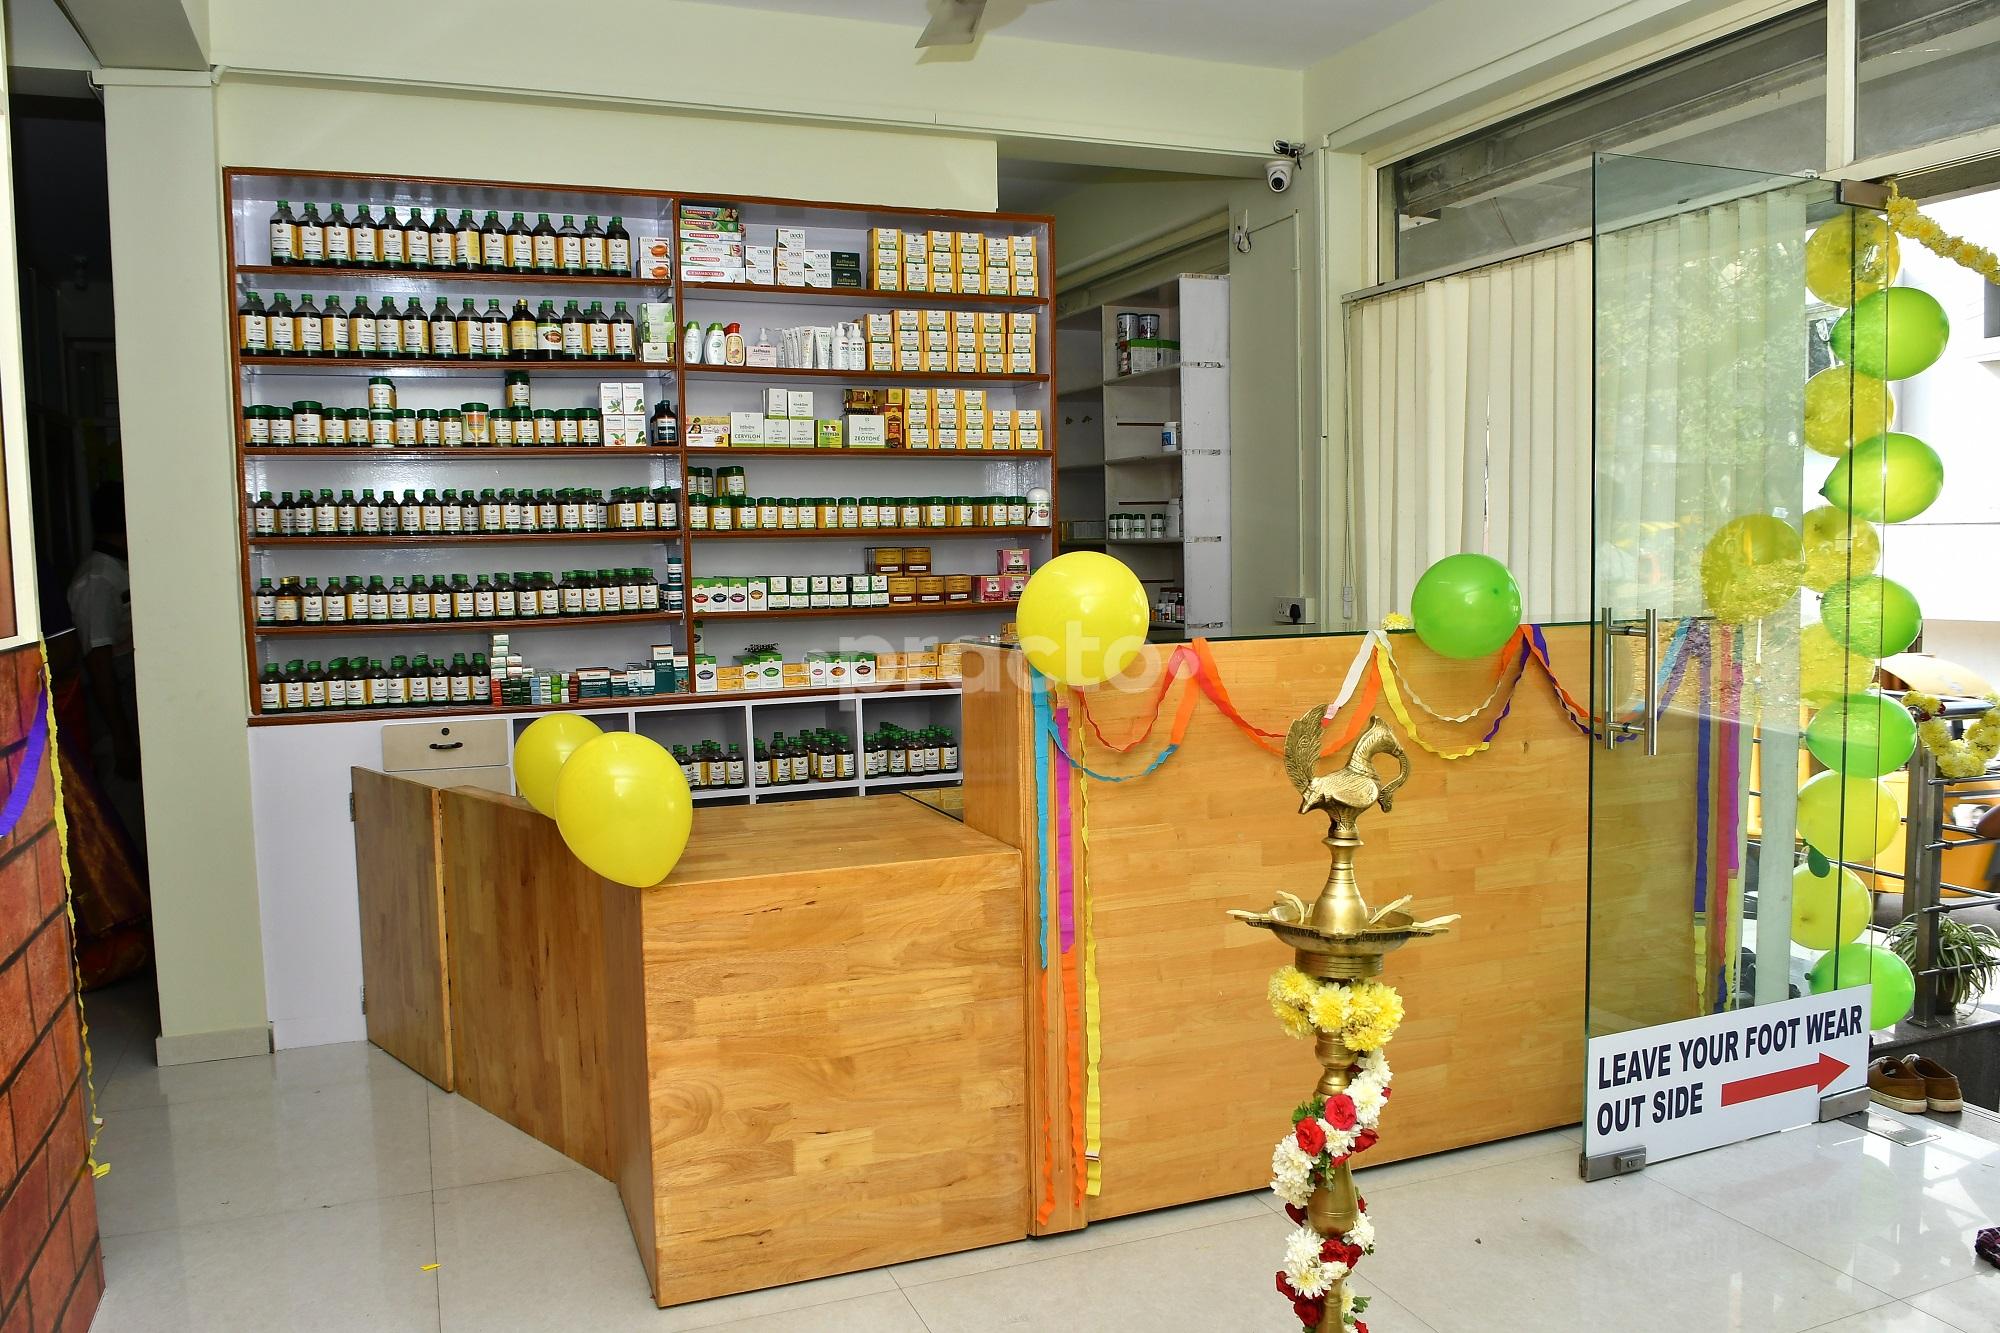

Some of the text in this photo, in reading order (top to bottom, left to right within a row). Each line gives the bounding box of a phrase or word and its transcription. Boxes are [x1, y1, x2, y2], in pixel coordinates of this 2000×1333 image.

[1598, 1004, 1863, 1090] LEAVE YOUR FOOT WEAR
[1596, 1082, 1704, 1137] OUT SIDE
